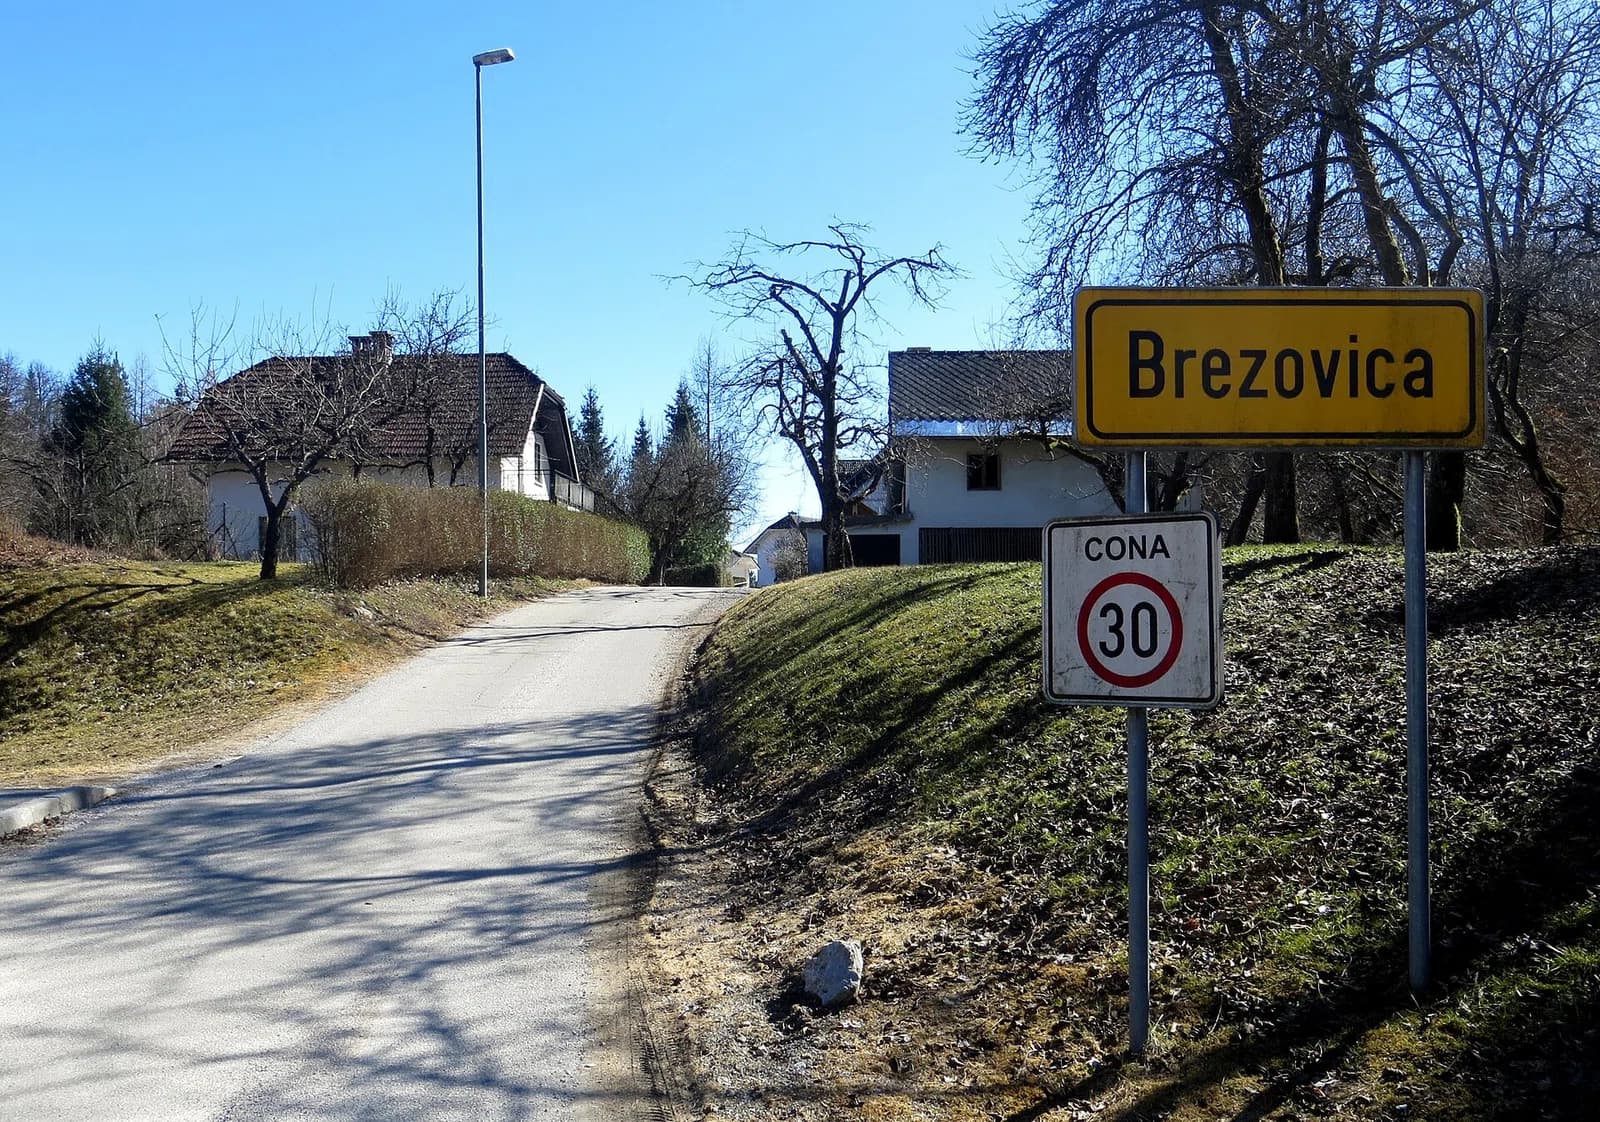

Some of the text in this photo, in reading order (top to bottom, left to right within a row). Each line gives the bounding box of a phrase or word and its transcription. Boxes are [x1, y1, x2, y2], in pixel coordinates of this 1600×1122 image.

[1129, 330, 1434, 399] Brezovica
[1084, 534, 1171, 562] CONA
[1098, 601, 1158, 659] 30
